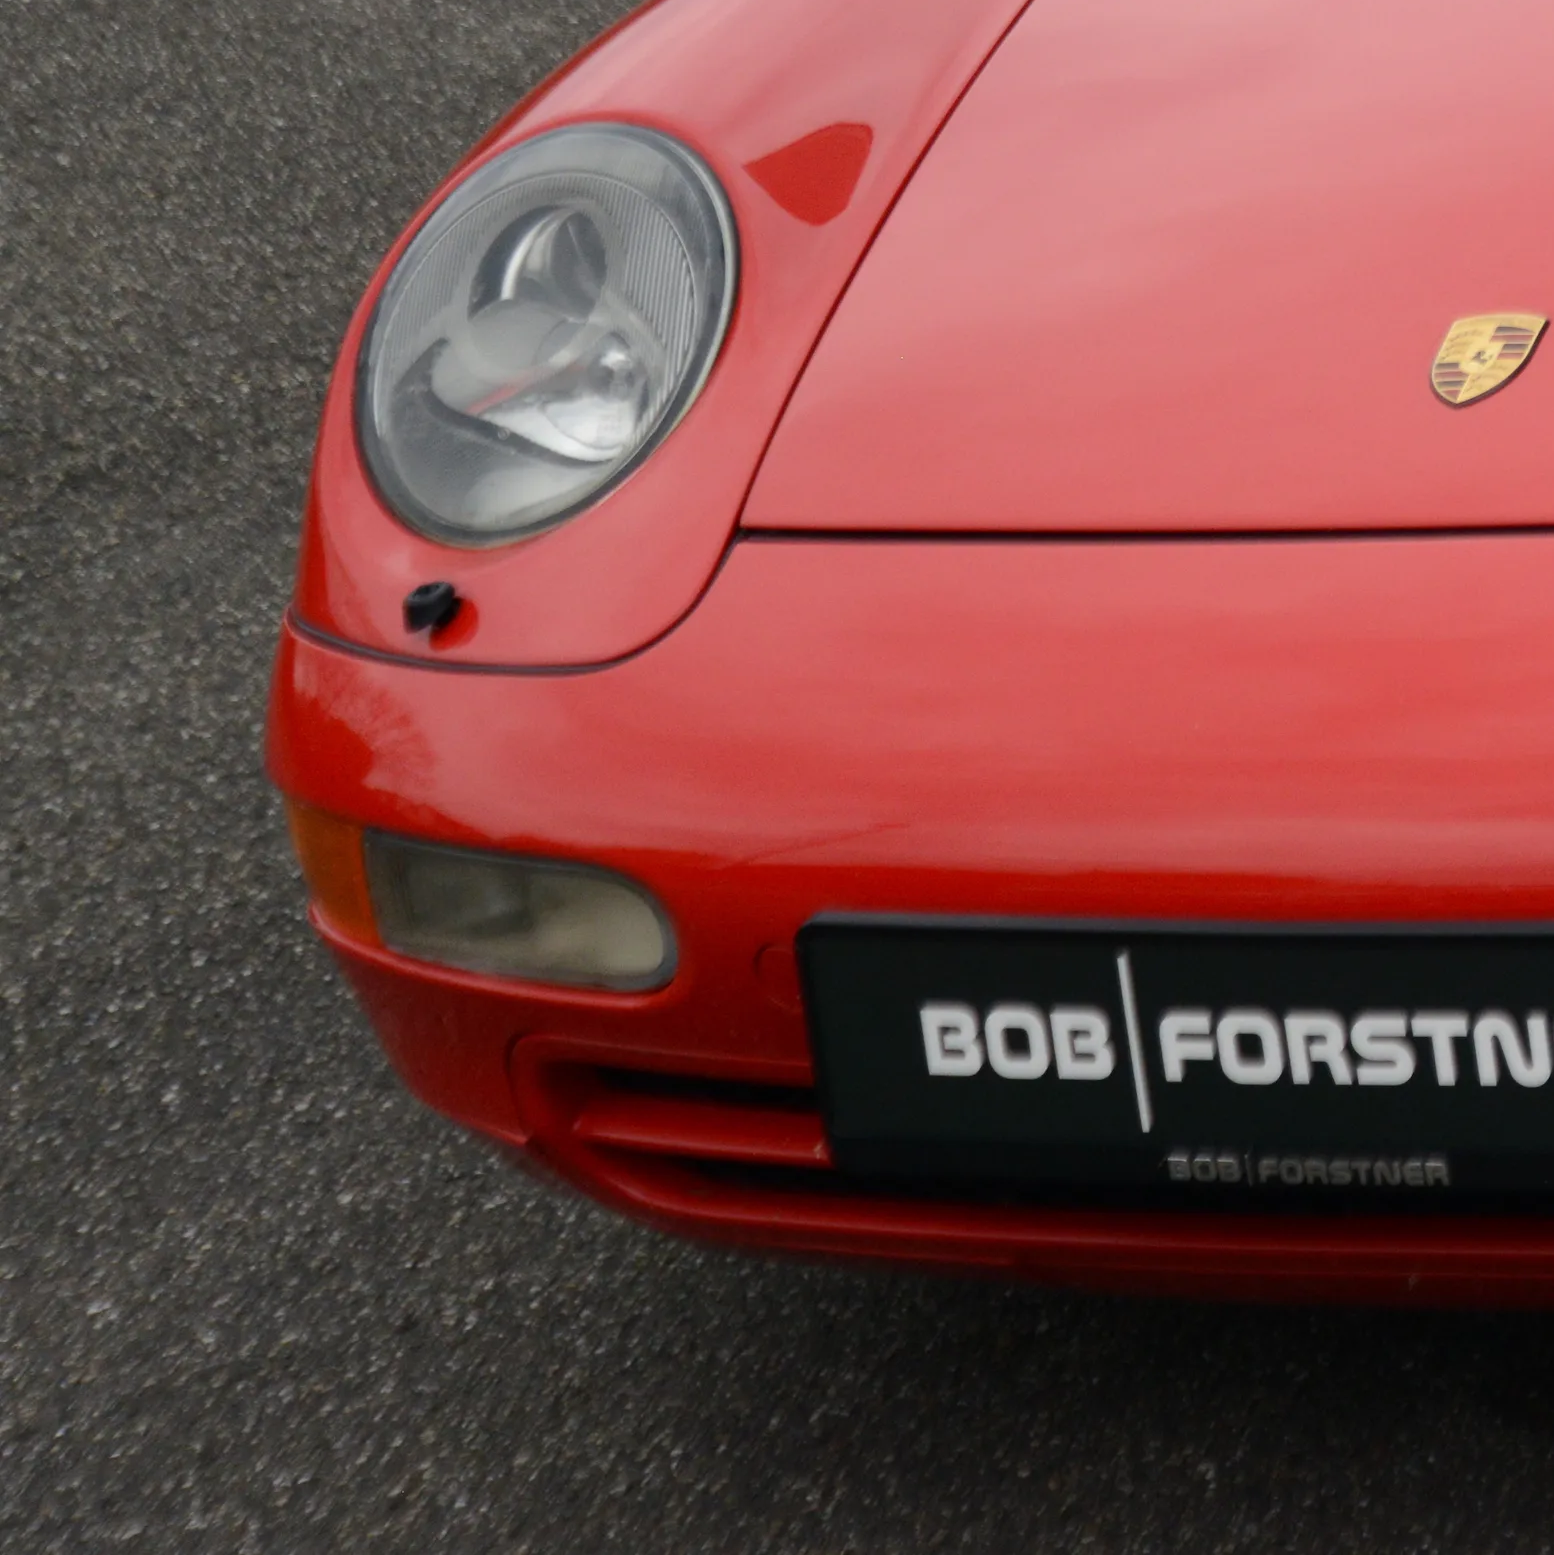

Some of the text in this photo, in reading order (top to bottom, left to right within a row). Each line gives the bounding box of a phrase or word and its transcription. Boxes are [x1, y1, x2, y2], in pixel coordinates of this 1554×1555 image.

[919, 1002, 1117, 1081] BOB
[1166, 1152, 1450, 1187] BOB FORSTNER
